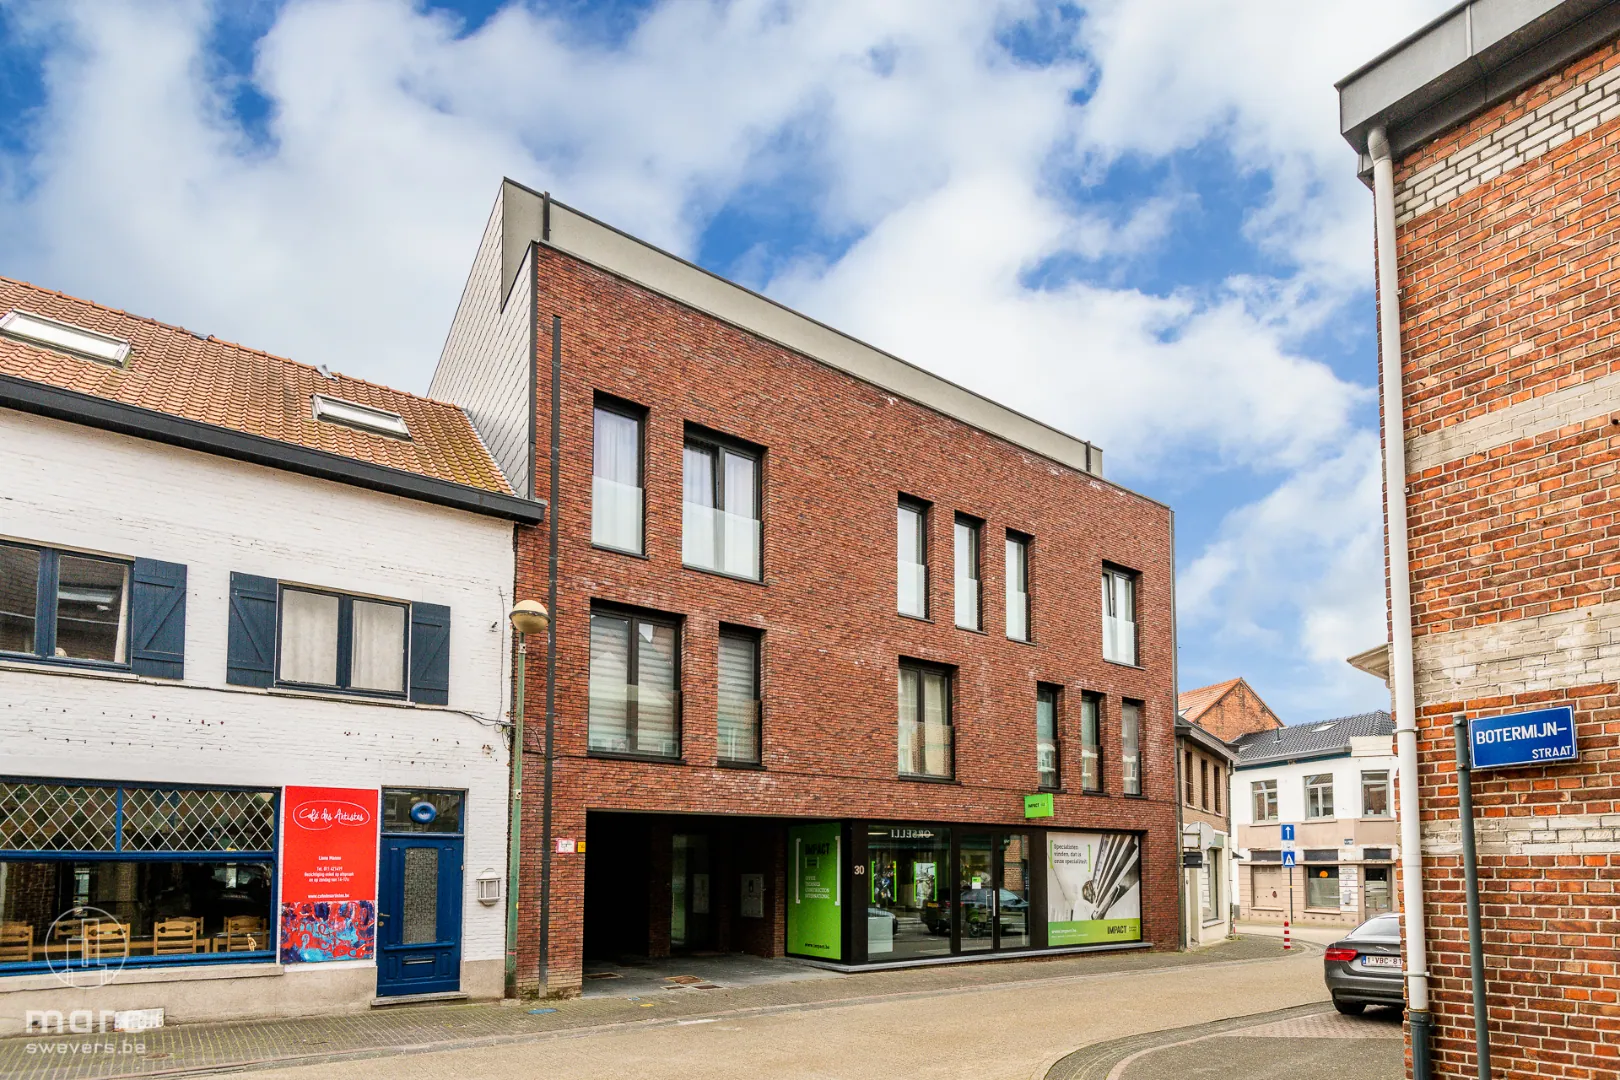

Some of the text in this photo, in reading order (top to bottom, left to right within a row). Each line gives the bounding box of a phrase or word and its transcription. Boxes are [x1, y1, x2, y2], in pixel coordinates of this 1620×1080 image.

[1476, 721, 1568, 745] BOTERMIJN-
[1531, 745, 1572, 759] STRAAT
[299, 808, 364, 823] Café des Artistes
[805, 843, 830, 855] IMPACT
[854, 865, 865, 875] 30
[1107, 926, 1127, 934] IMPACT
